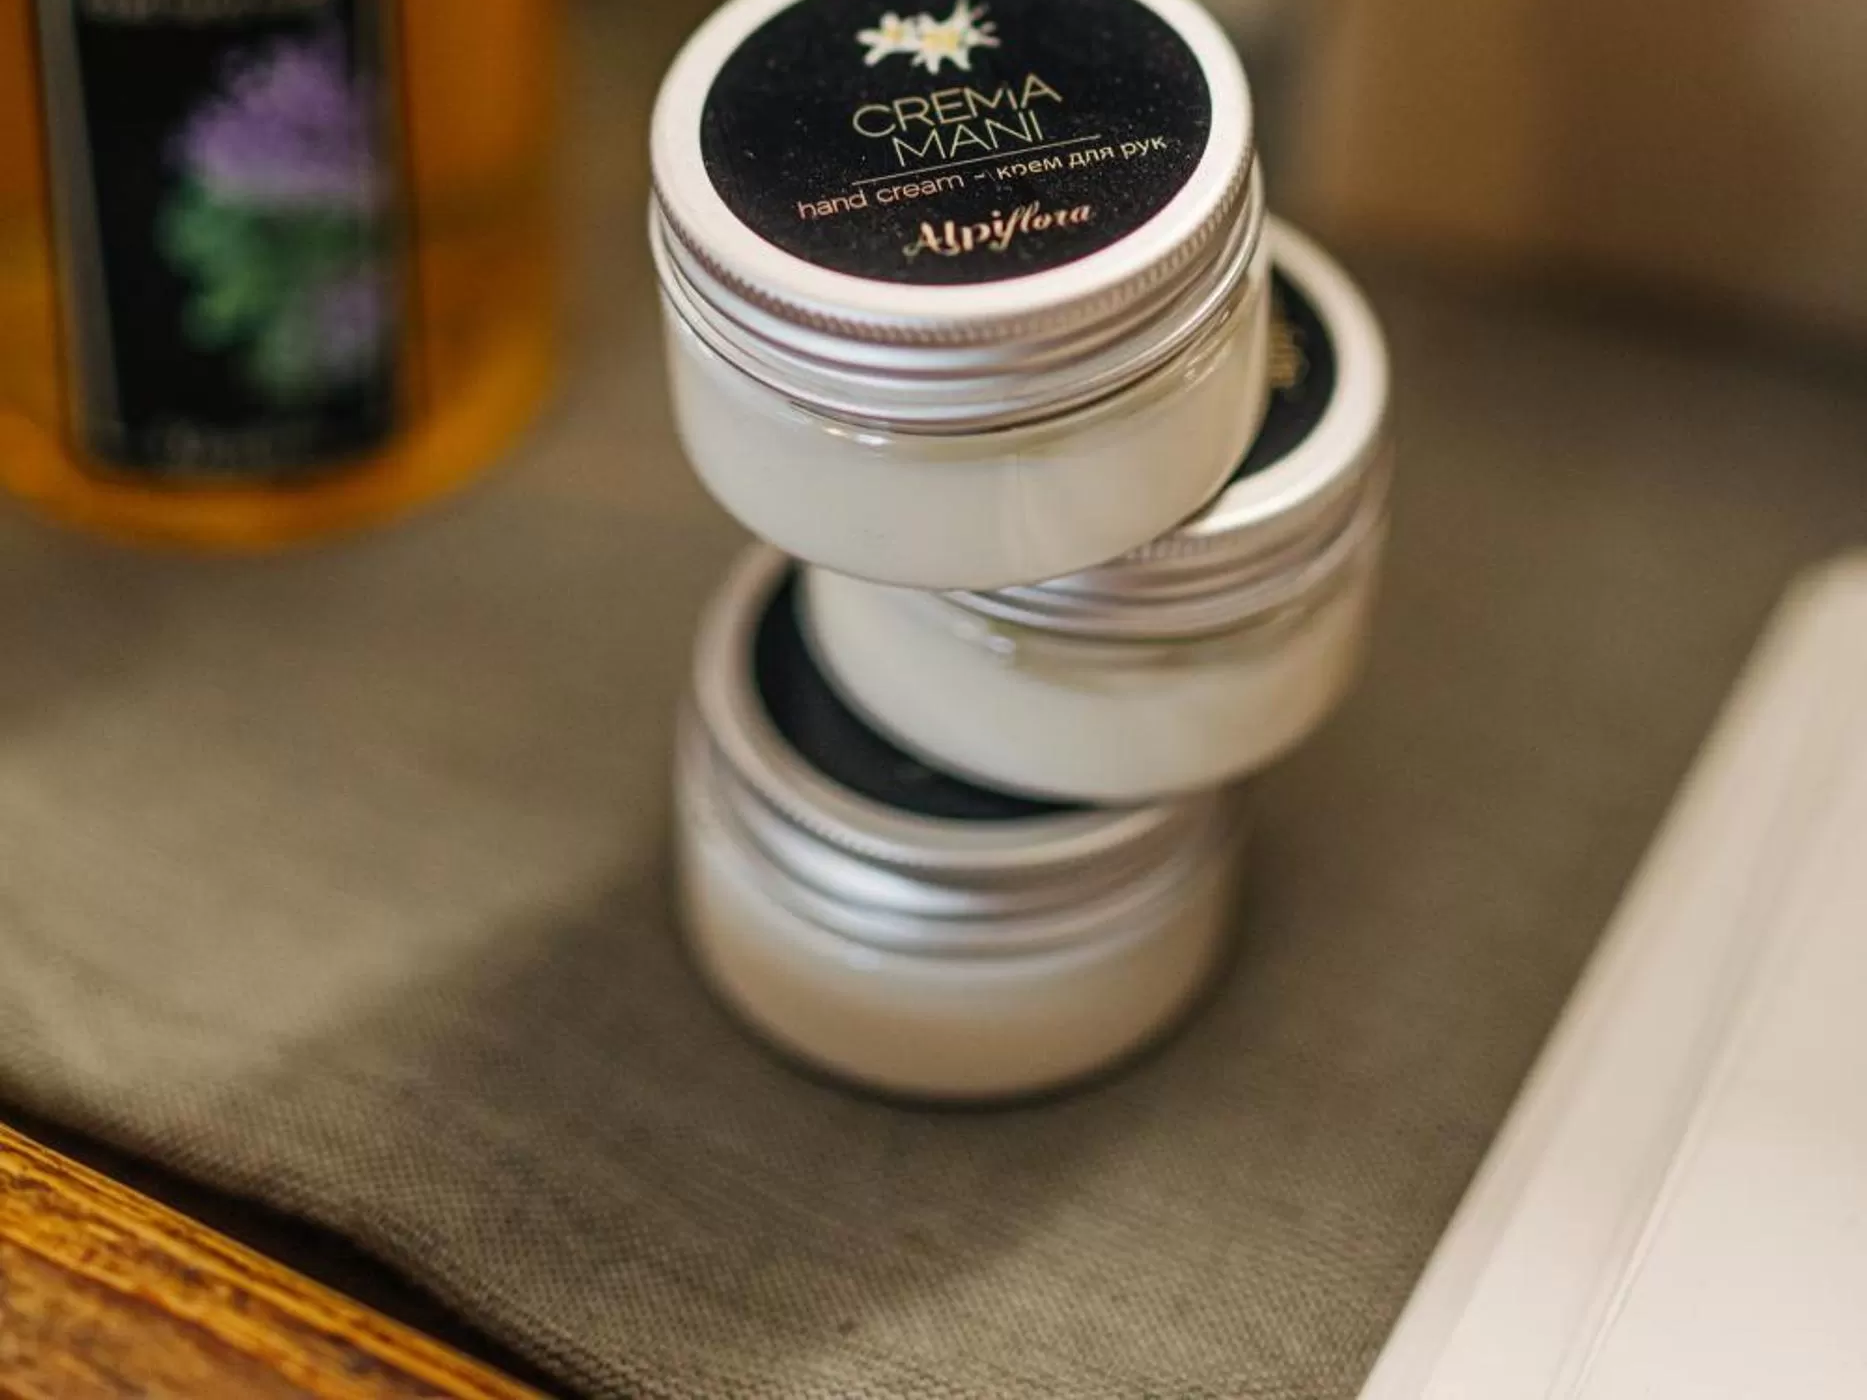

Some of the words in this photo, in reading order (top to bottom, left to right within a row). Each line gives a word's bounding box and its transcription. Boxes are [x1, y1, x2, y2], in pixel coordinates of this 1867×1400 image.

[853, 73, 1063, 138] CREMA
[891, 109, 1044, 167] MANI
[797, 188, 868, 220] hand
[876, 173, 965, 204] cream
[996, 155, 1063, 182] крем
[1068, 146, 1116, 169] для
[1120, 135, 1169, 160] рук
[902, 200, 1092, 258] Alpiflora
